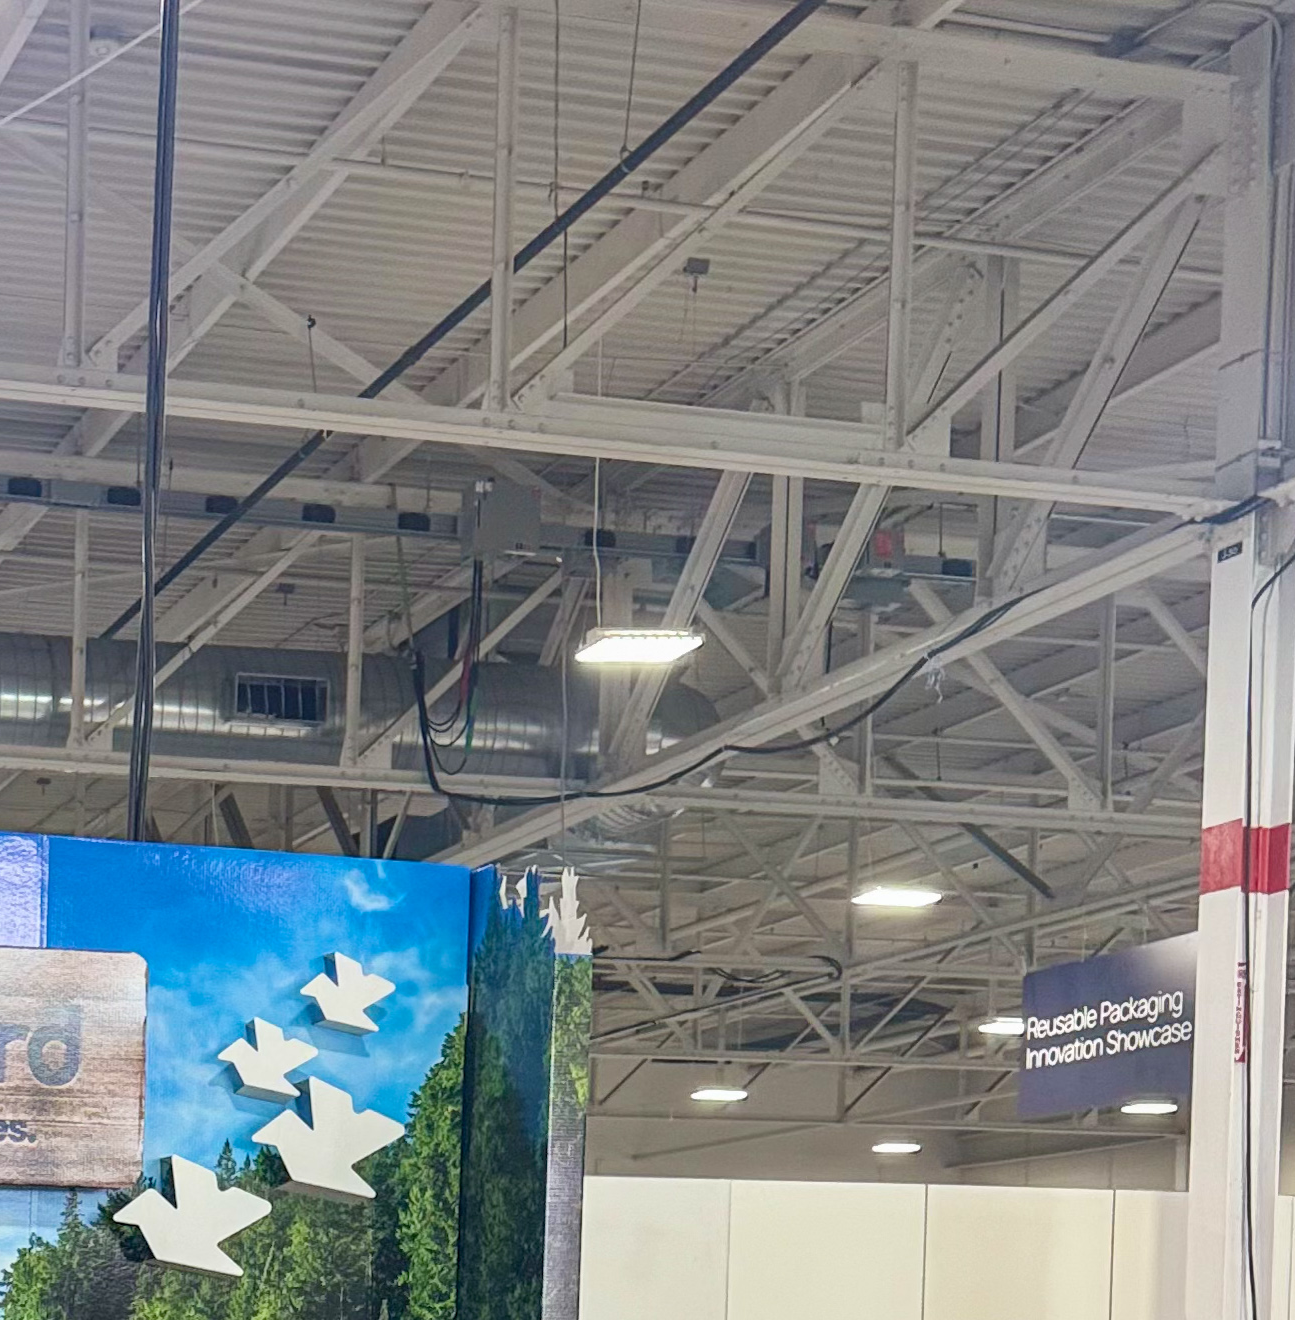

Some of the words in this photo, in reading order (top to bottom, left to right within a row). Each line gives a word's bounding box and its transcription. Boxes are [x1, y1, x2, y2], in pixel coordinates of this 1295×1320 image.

[1026, 1006, 1097, 1041] Reusable
[1100, 990, 1184, 1026] Packaging
[1025, 1036, 1103, 1070] Innovation
[1105, 1020, 1193, 1055] Showcase
